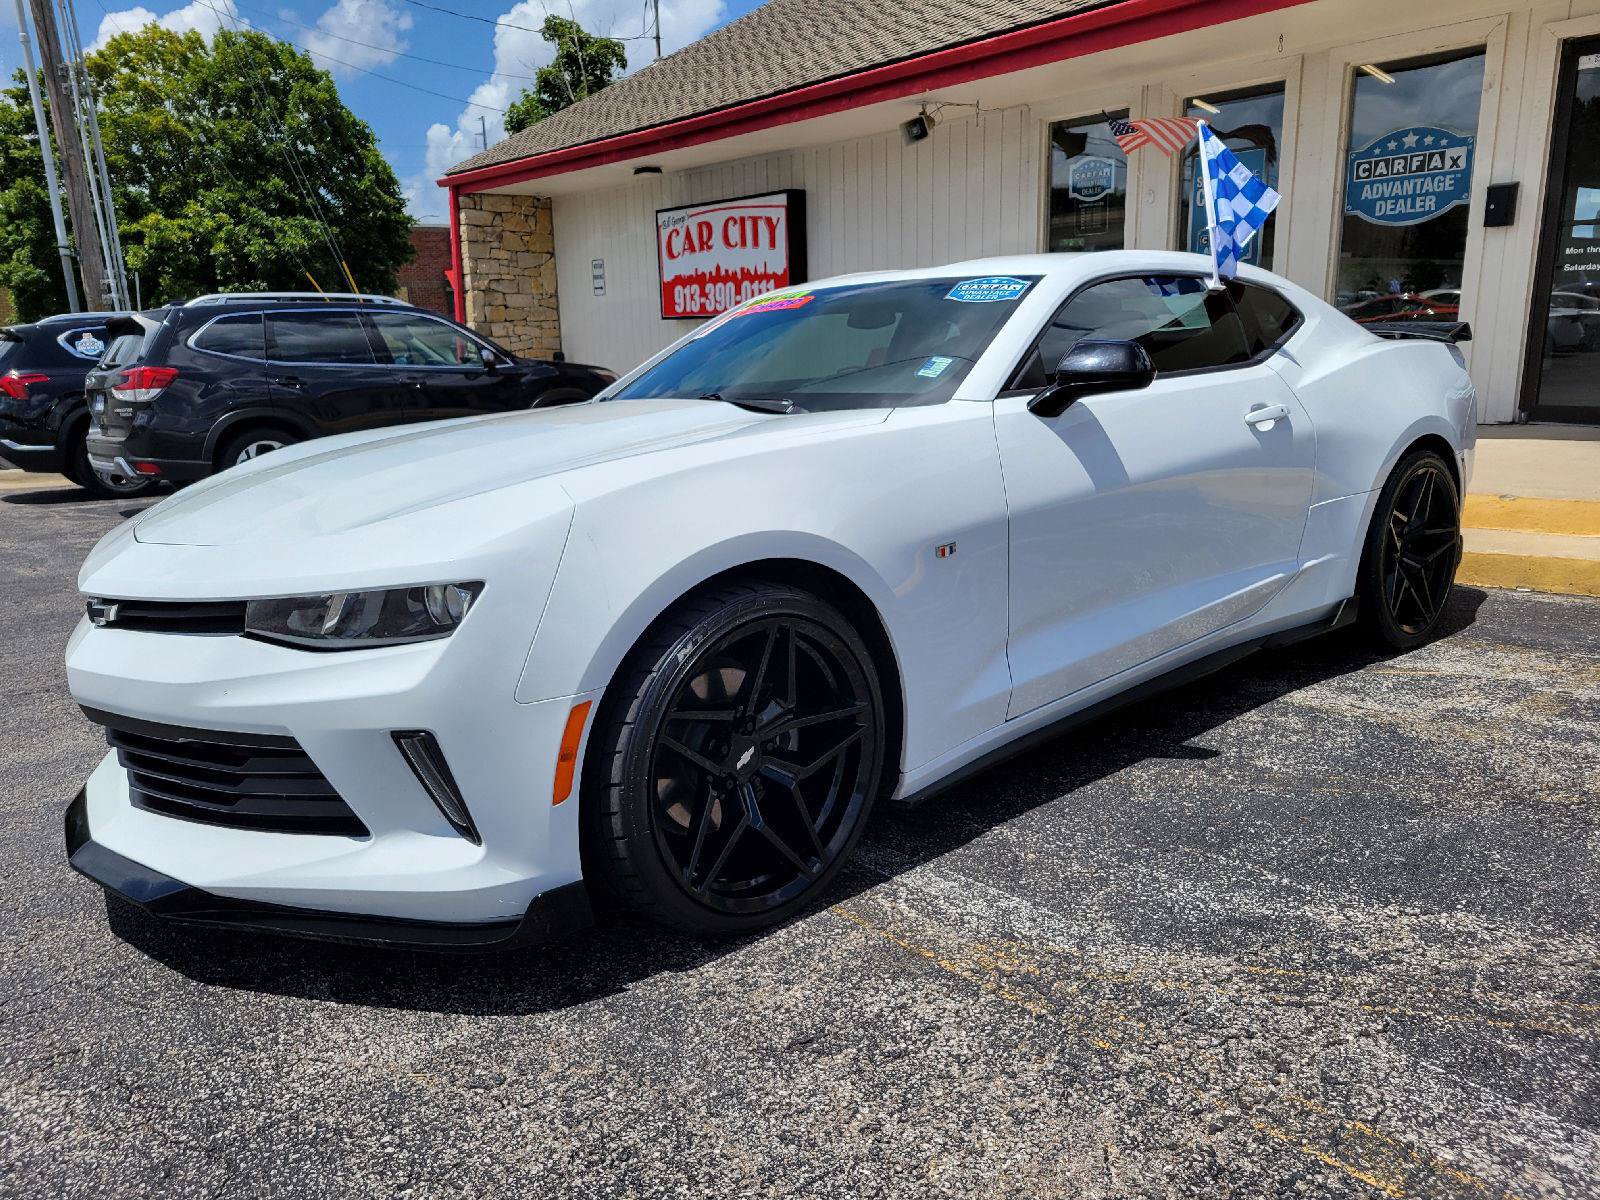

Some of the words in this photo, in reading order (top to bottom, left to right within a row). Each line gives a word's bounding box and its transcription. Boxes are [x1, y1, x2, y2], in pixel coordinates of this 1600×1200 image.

[1074, 168, 1111, 180] CARFAX
[1357, 152, 1464, 179] CARFAX
[1081, 186, 1102, 196] DEALER
[1361, 174, 1456, 200] ADVANTAGE
[1375, 195, 1437, 217] DEALER
[665, 220, 714, 261] CAR
[722, 215, 781, 251] CITY
[1565, 247, 1584, 255] Mon
[1587, 245, 1600, 253] thr
